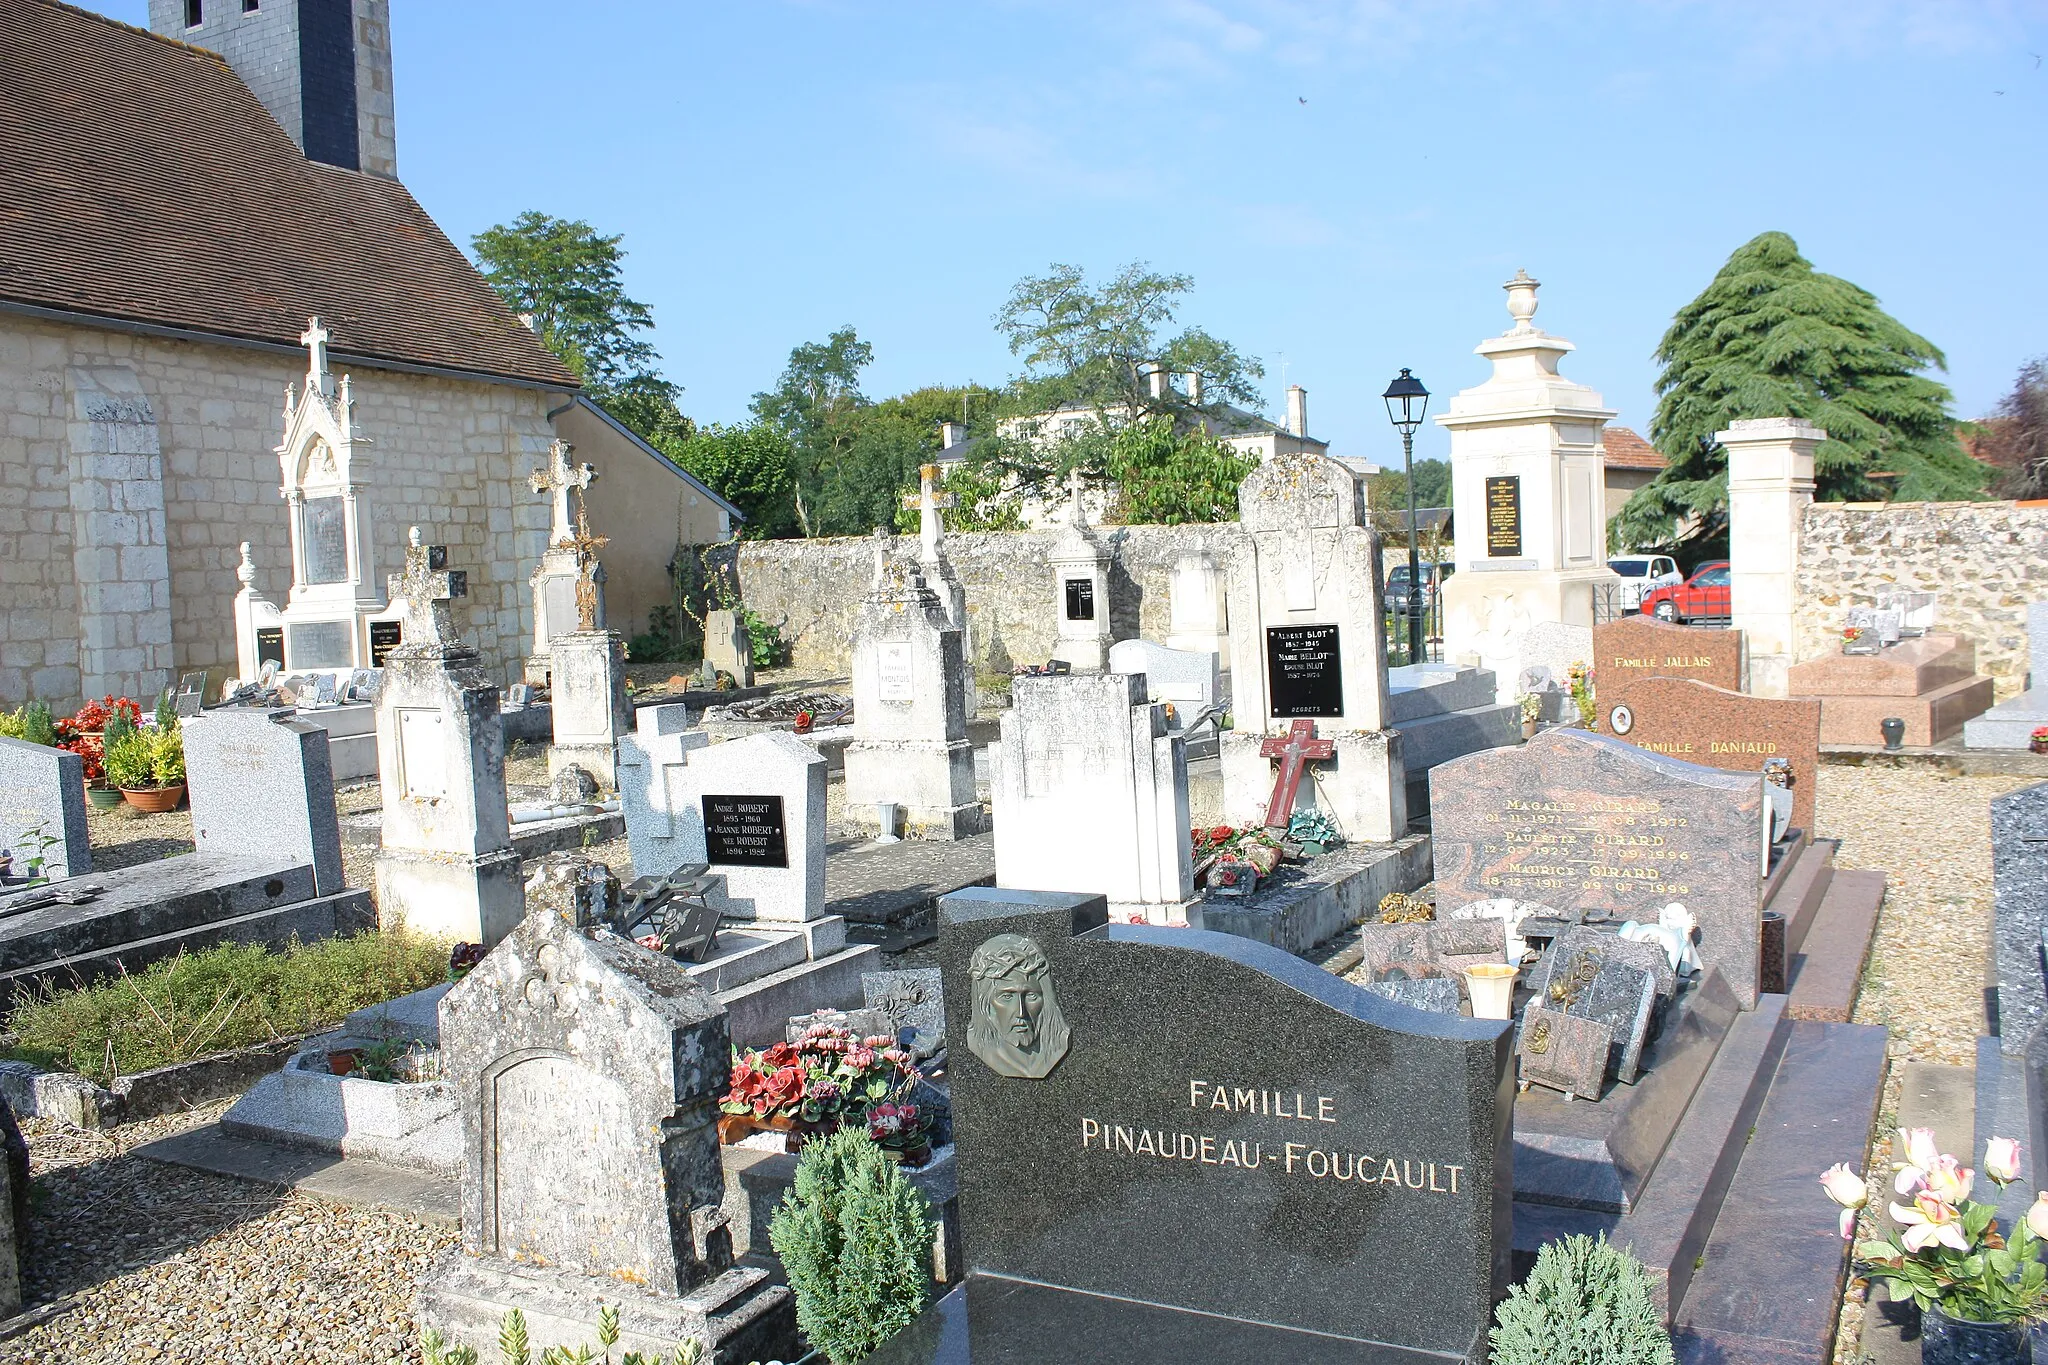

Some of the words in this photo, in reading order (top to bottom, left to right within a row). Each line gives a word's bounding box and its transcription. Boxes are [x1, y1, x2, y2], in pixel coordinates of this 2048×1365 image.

[1307, 630, 1327, 639] BLOT
[1279, 653, 1298, 661] MARIE
[1300, 652, 1328, 660] BELLOT
[1306, 662, 1325, 670] BLOT
[1614, 657, 1657, 668] FAMILLE
[1663, 656, 1712, 668] JALLAIS
[1637, 741, 1694, 753] FAMILLE
[1711, 742, 1776, 754] DANIAUD
[714, 803, 734, 813] ANDRÉ
[737, 804, 769, 813] ROBERT
[1505, 800, 1577, 812] MAGALIE
[1592, 801, 1662, 814] GIRARD
[745, 815, 761, 823] 1960
[714, 825, 740, 834] JEANNE
[741, 825, 773, 835] ROBERT
[736, 837, 768, 846] ROBERT
[1505, 831, 1578, 844] PAULETTE
[1594, 834, 1664, 846] GIRARD
[1508, 863, 1576, 876] MAURICE
[1589, 865, 1659, 879] GIRARD
[1190, 1079, 1337, 1123] FAMILLE
